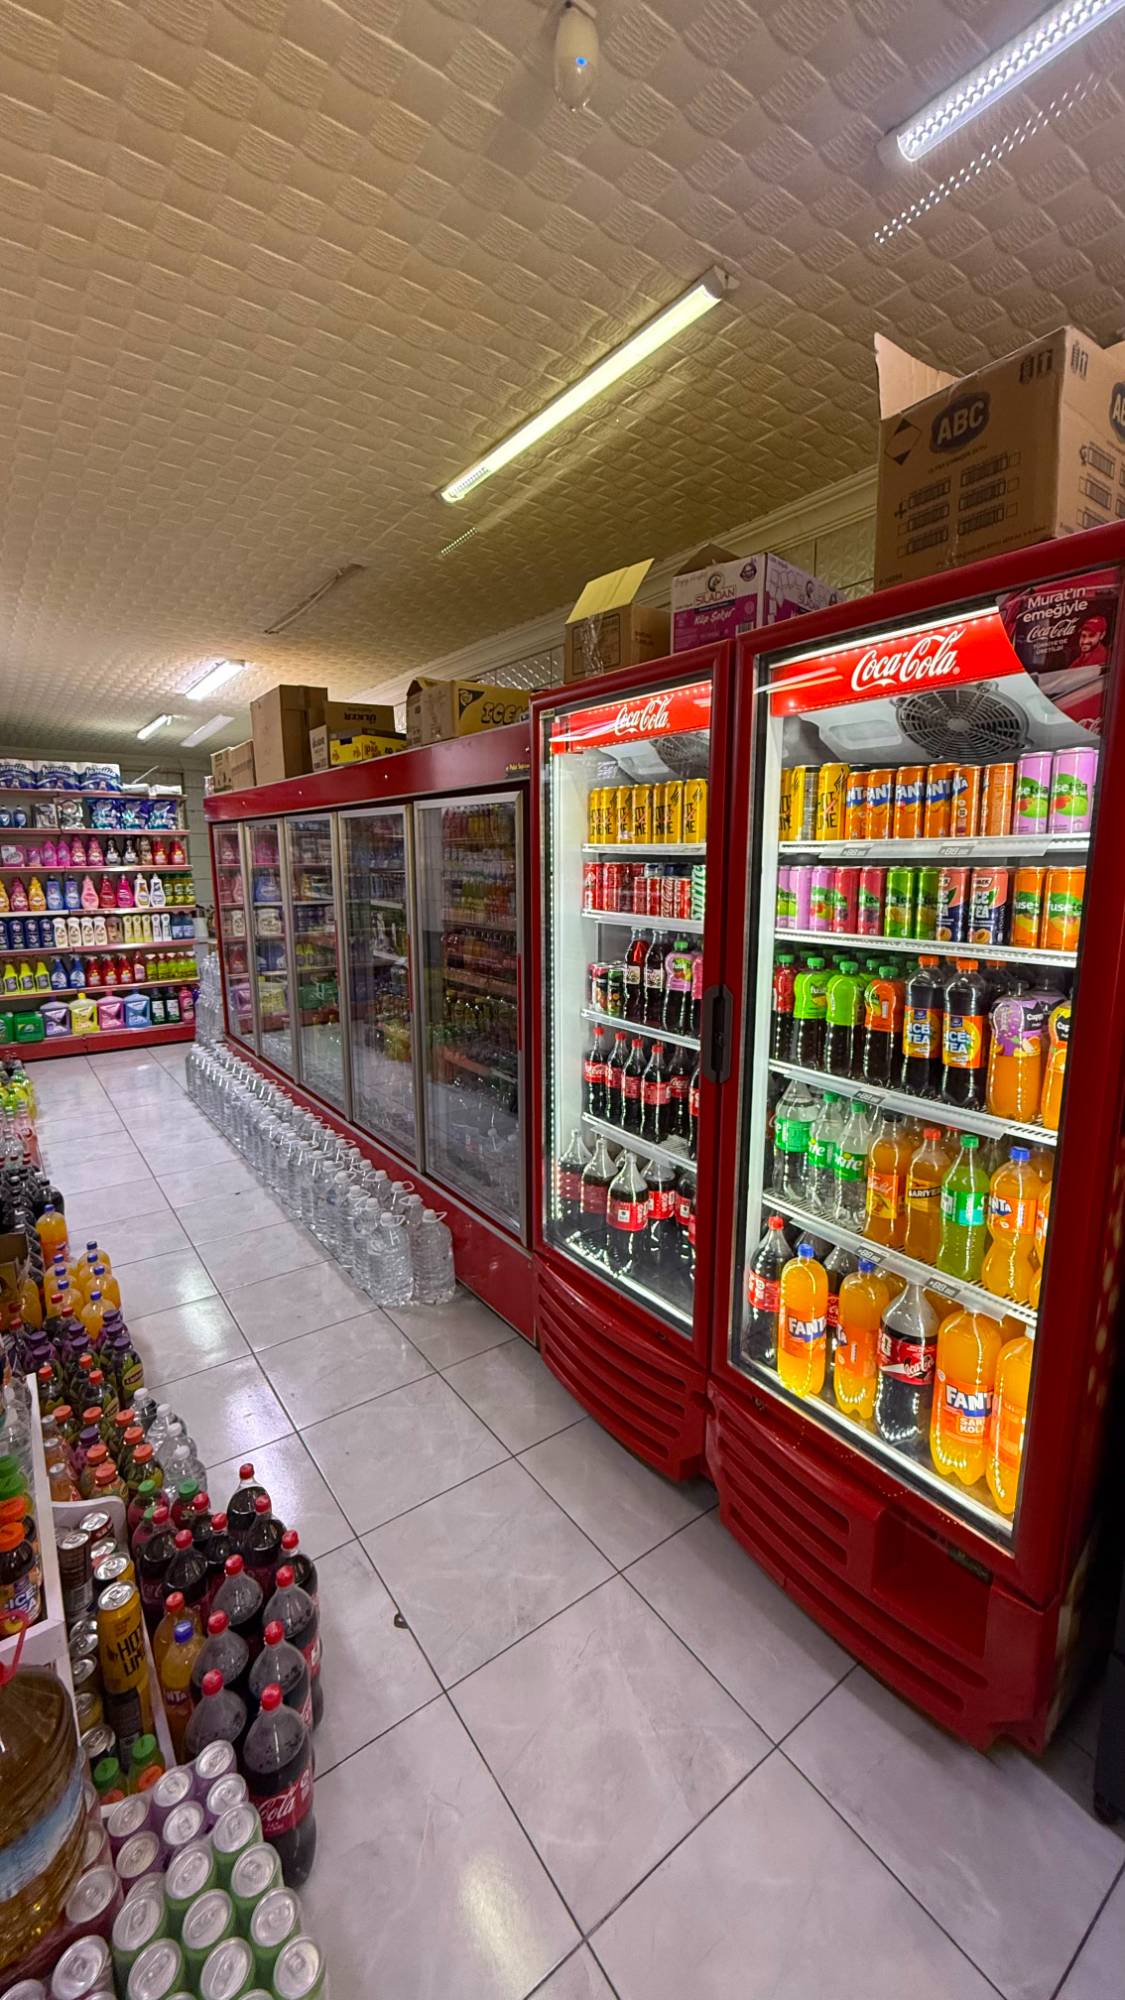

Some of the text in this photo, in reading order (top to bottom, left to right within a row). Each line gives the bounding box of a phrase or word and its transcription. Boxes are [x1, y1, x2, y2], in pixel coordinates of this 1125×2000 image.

[936, 401, 985, 446] ABC
[1023, 600, 1088, 622] emeğiyle
[851, 626, 967, 692] Coca-Cola
[614, 695, 672, 736] Coca-Cola
[907, 1023, 931, 1034] ICE
[907, 1033, 931, 1045] TEA
[945, 1042, 968, 1054] TEA
[788, 1315, 826, 1335] FANT
[946, 1384, 993, 1412] FANT
